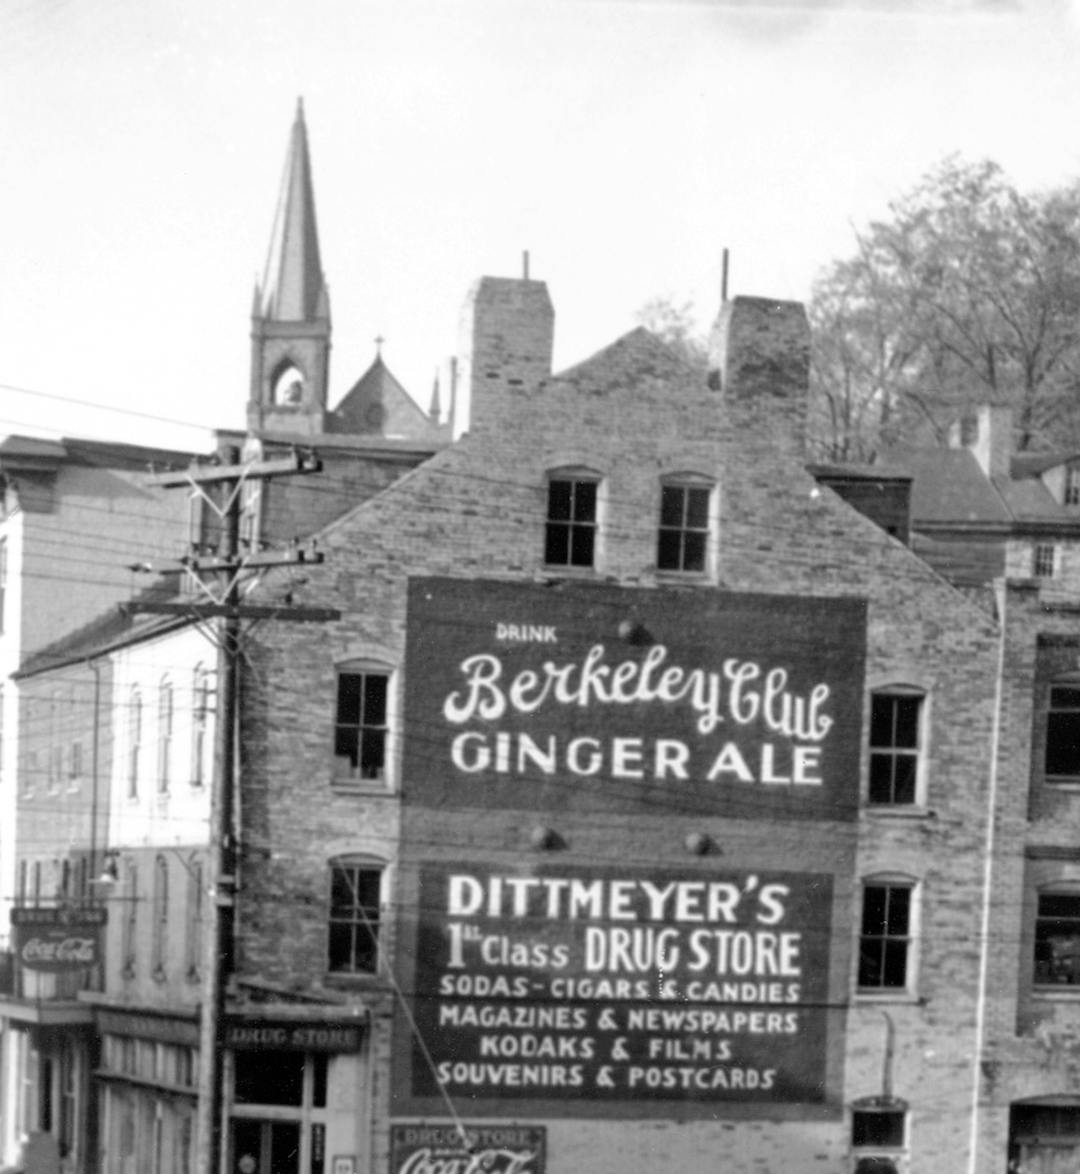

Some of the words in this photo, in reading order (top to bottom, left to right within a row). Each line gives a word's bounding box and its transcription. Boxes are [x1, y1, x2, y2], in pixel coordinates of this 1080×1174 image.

[495, 622, 557, 642] DRINK
[443, 645, 723, 734] Berkeley
[722, 658, 833, 741] Club
[451, 732, 689, 779] GINGER
[707, 741, 824, 785] ALE
[447, 875, 790, 924] DITTMEYER'S
[481, 934, 569, 968] Class
[585, 926, 680, 972] DRUG
[688, 929, 801, 976] STORE
[439, 974, 528, 997] SODAS
[551, 978, 650, 999] CIGARS
[661, 980, 677, 999] &
[687, 982, 800, 1003] CANDIES
[439, 1004, 586, 1030] MAGAZINES
[598, 1008, 617, 1030] &
[629, 1009, 798, 1034] NEWSPAPERS
[231, 1028, 287, 1044] DRUG
[480, 1034, 594, 1059] KODAKS
[612, 1037, 629, 1060] &
[649, 1039, 732, 1061] FILMS
[437, 1062, 583, 1086] SOUVENIRS
[597, 1066, 615, 1088] &
[628, 1067, 777, 1090] POSTCARDS
